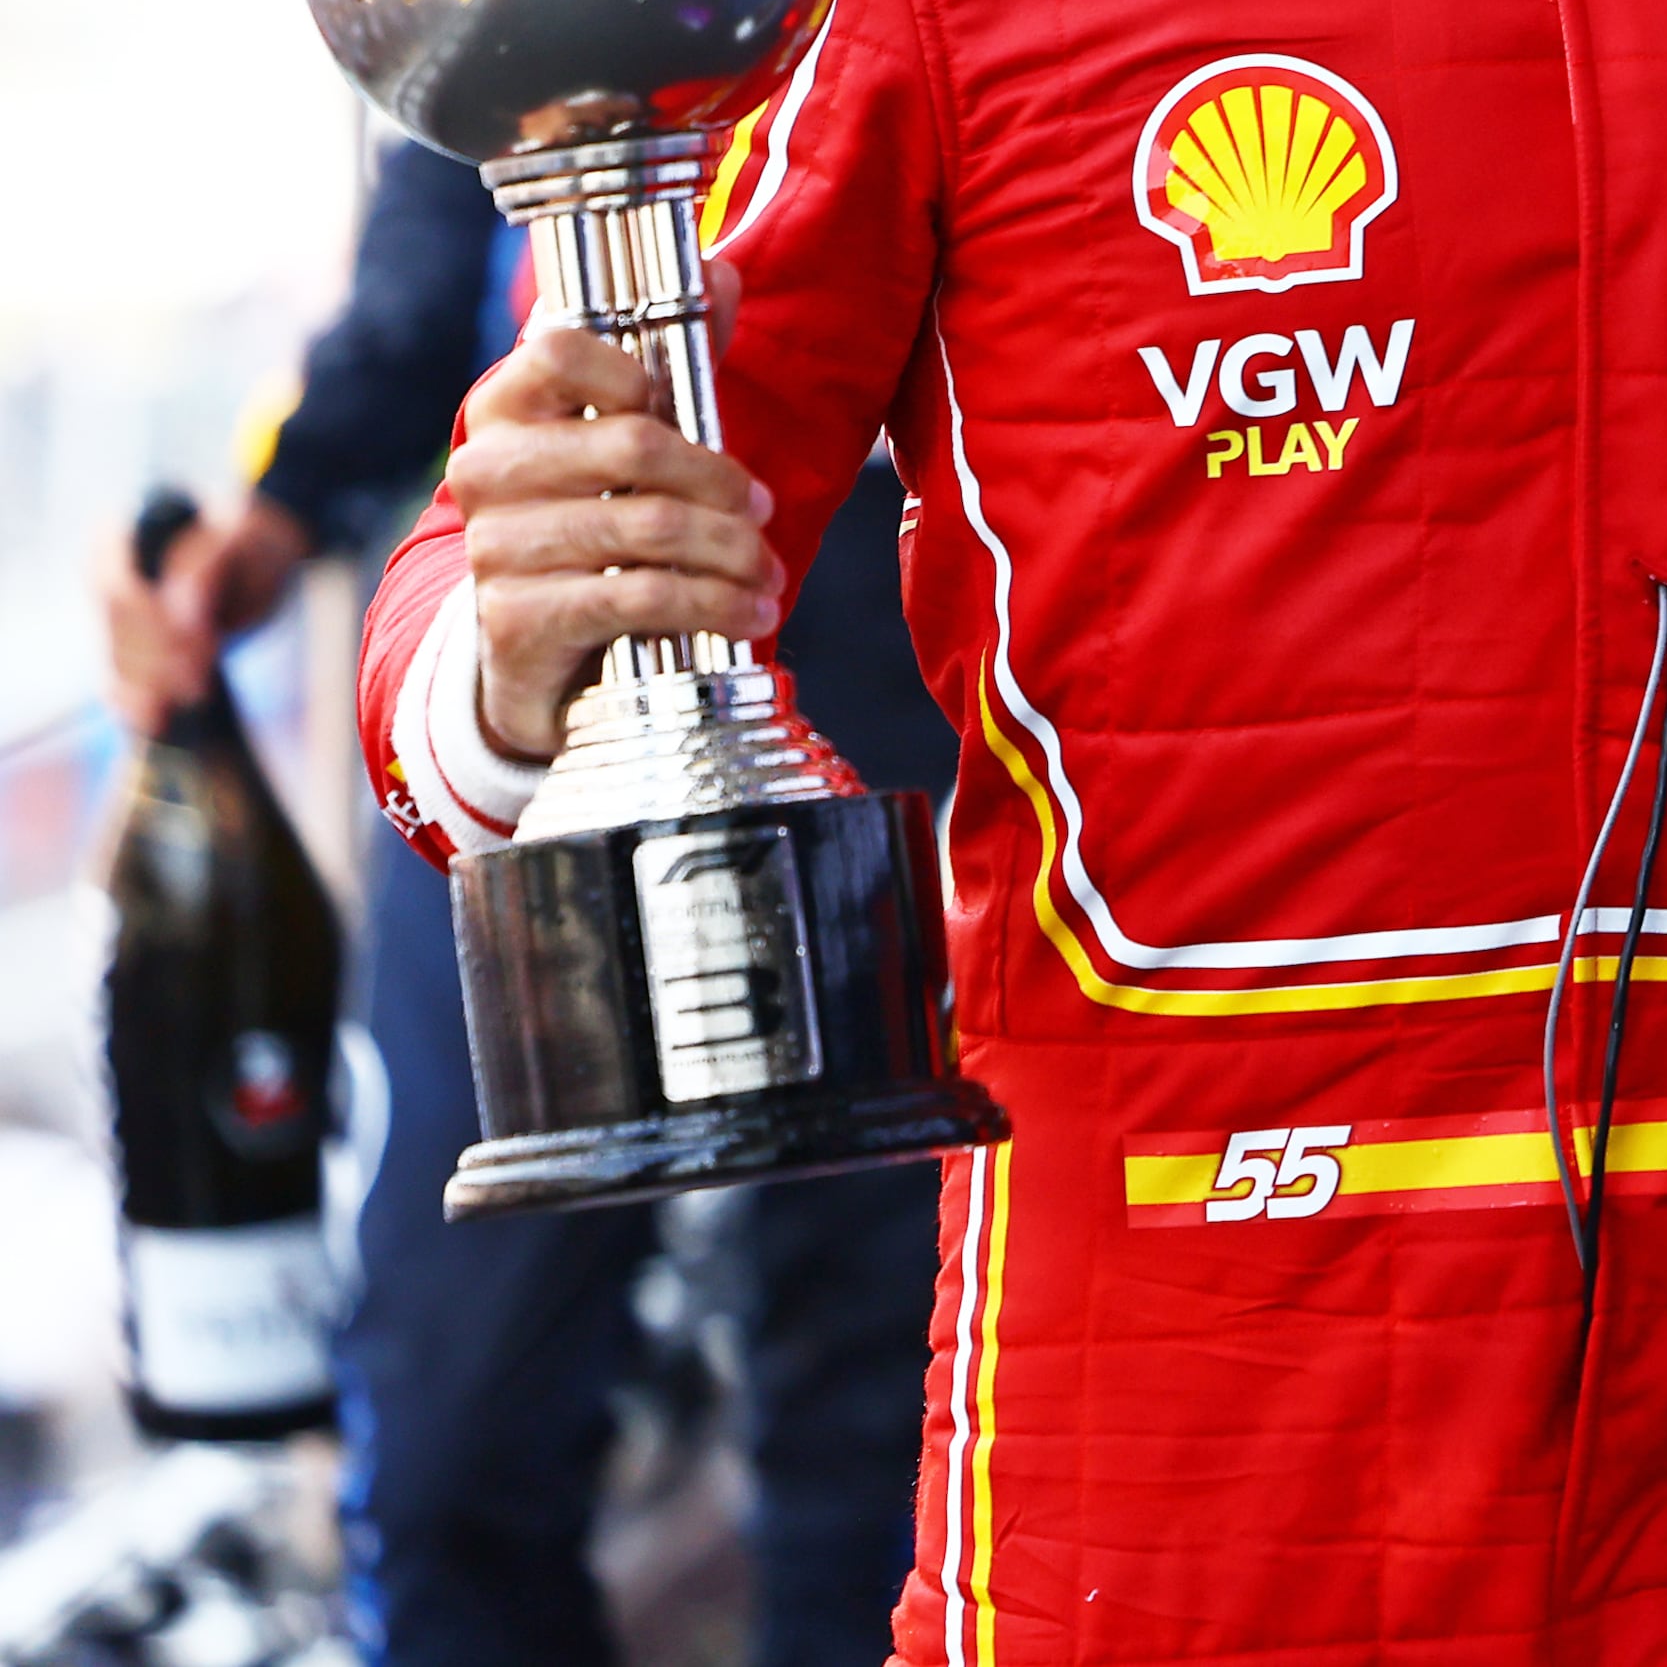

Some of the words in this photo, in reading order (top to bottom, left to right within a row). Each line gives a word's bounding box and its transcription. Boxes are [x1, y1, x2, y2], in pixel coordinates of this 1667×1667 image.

[1137, 318, 1416, 427] VGW
[1206, 417, 1360, 479] PLAY
[1206, 1124, 1353, 1223] 55
